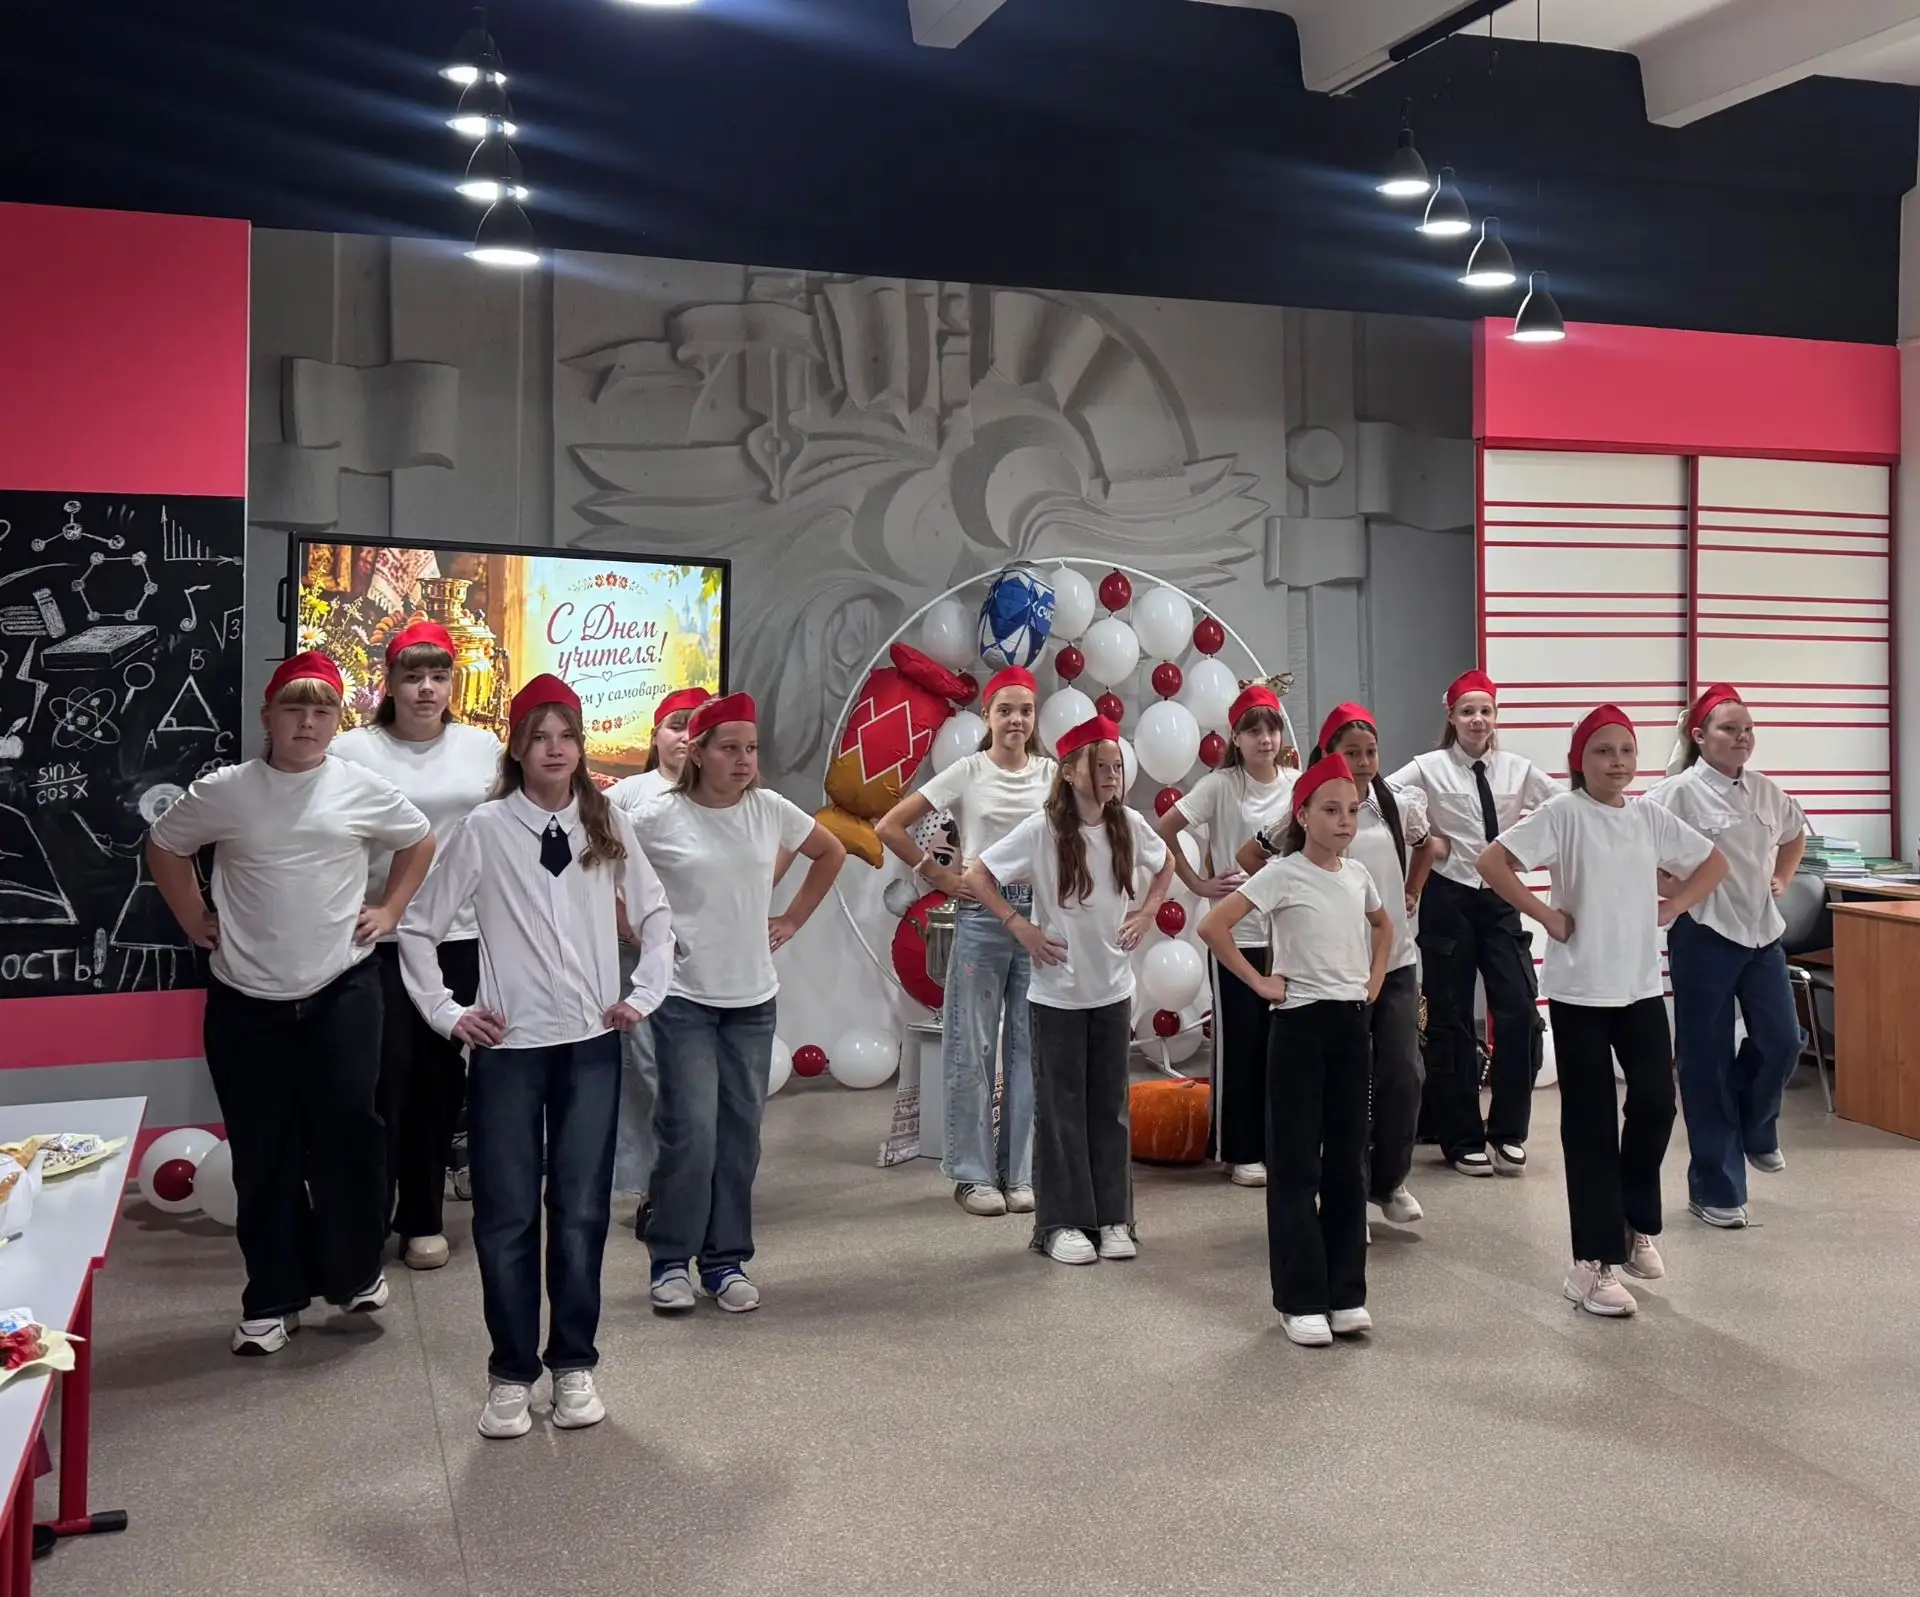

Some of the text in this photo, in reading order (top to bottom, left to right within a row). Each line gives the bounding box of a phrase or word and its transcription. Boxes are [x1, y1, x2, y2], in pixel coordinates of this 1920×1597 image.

[546, 600, 659, 645] С Днем
[555, 631, 669, 682] учителя!
[595, 690, 605, 708] у
[607, 680, 673, 702] самовара»
[36, 761, 65, 783] sin
[35, 785, 69, 805] cos
